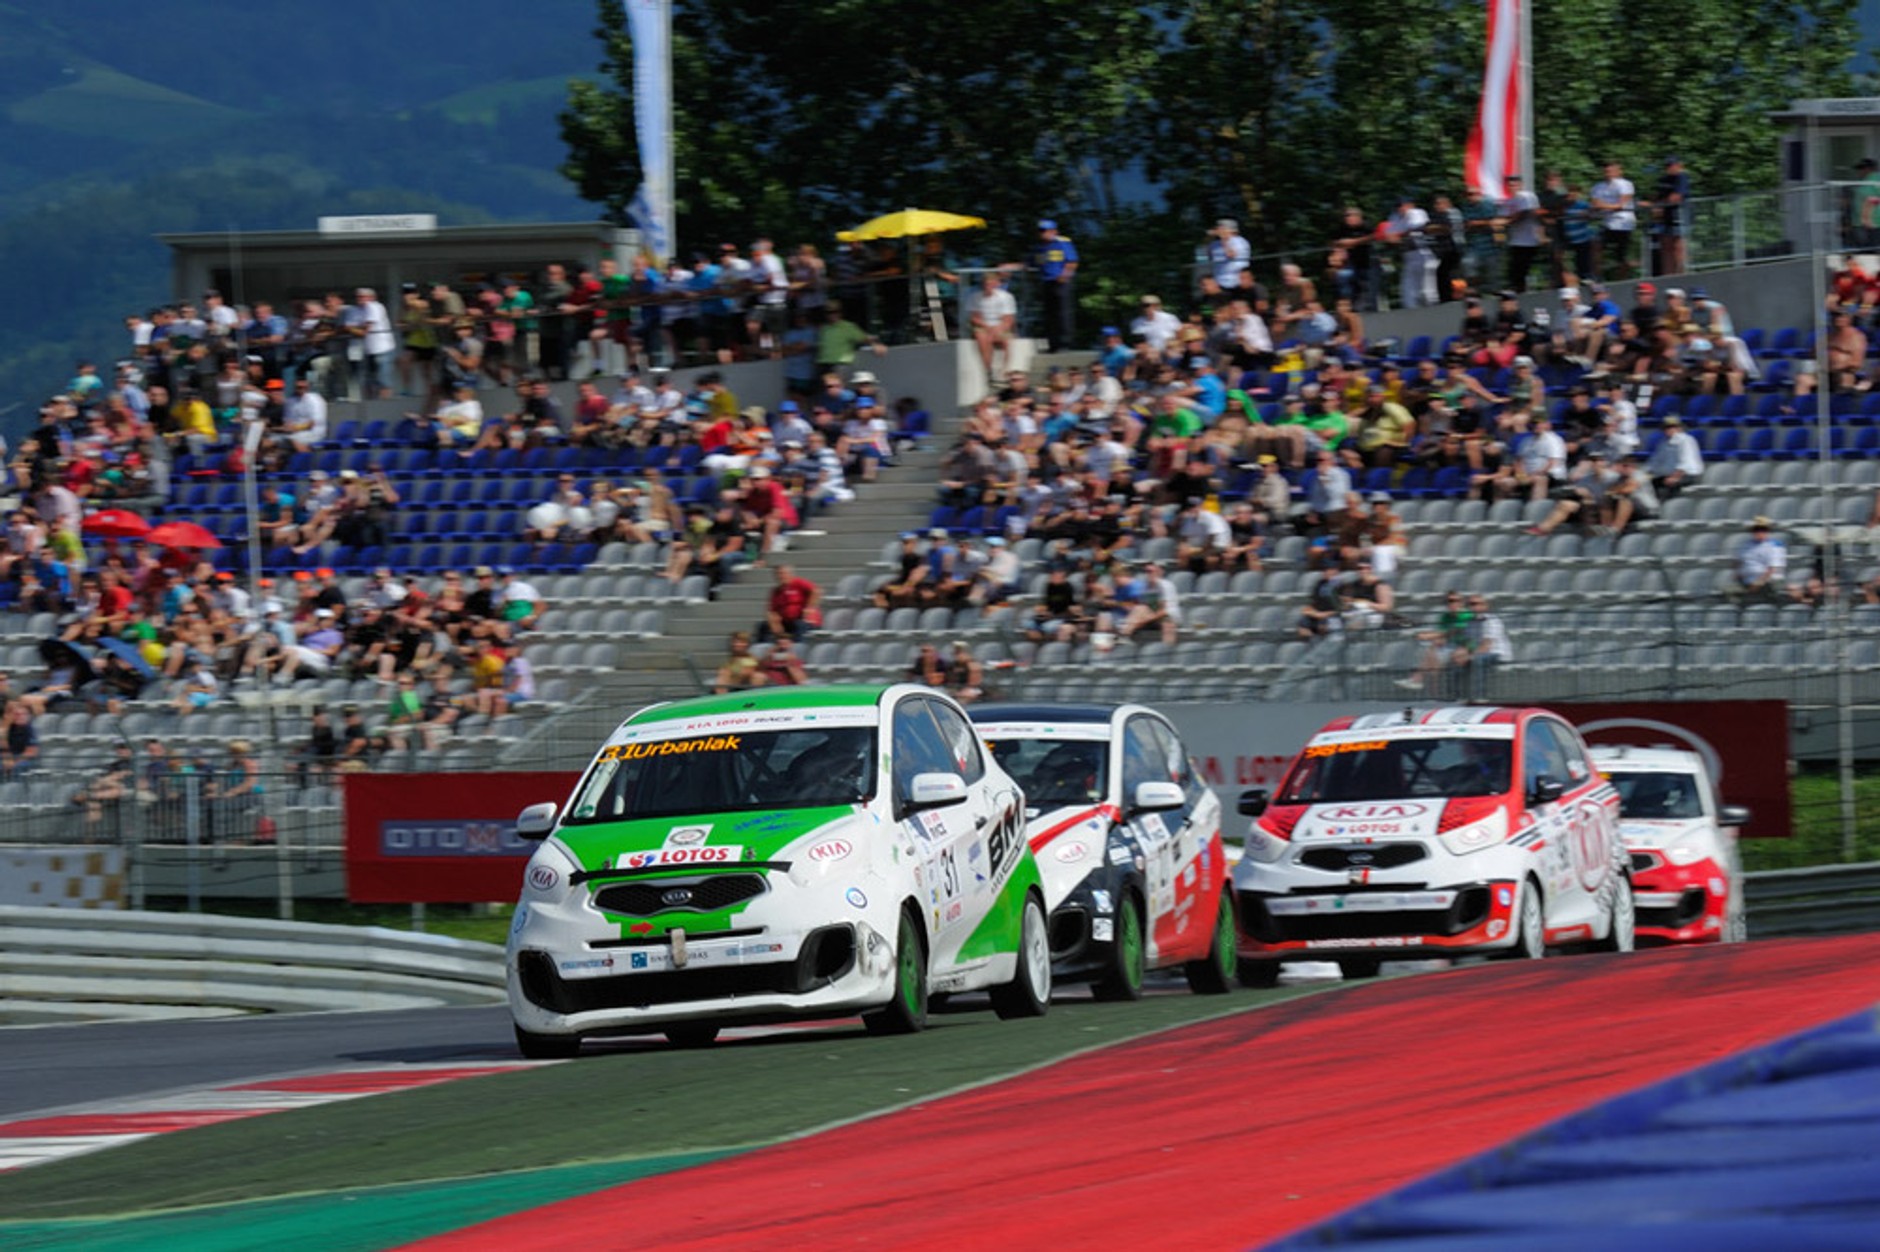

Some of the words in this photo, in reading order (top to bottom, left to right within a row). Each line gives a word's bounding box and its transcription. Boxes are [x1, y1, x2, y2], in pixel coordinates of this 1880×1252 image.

[1336, 805, 1405, 818] KIA
[1349, 823, 1401, 834] LOTOS
[660, 848, 730, 863] LOTOS
[817, 842, 848, 863] KIA
[532, 870, 554, 888] KIA
